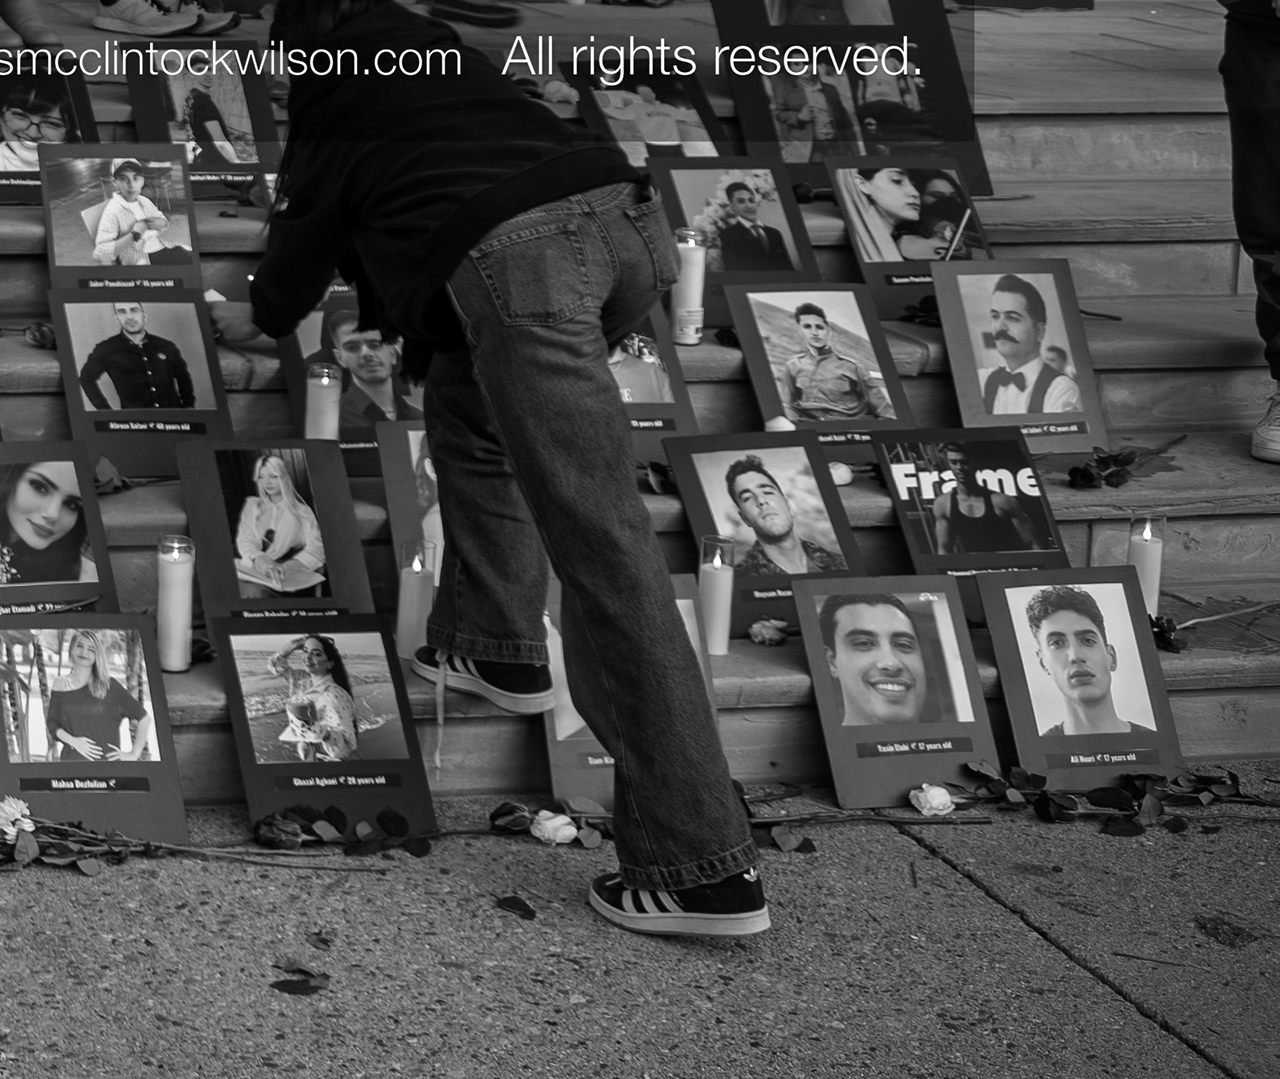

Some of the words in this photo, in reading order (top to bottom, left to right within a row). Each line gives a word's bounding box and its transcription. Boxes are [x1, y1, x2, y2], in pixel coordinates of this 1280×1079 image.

[925, 742, 943, 752] years
[942, 740, 954, 750] old
[1110, 754, 1128, 764] years
[1127, 752, 1138, 762] old
[51, 778, 75, 789] Mahsa
[357, 777, 375, 787] years
[374, 775, 387, 785] old
